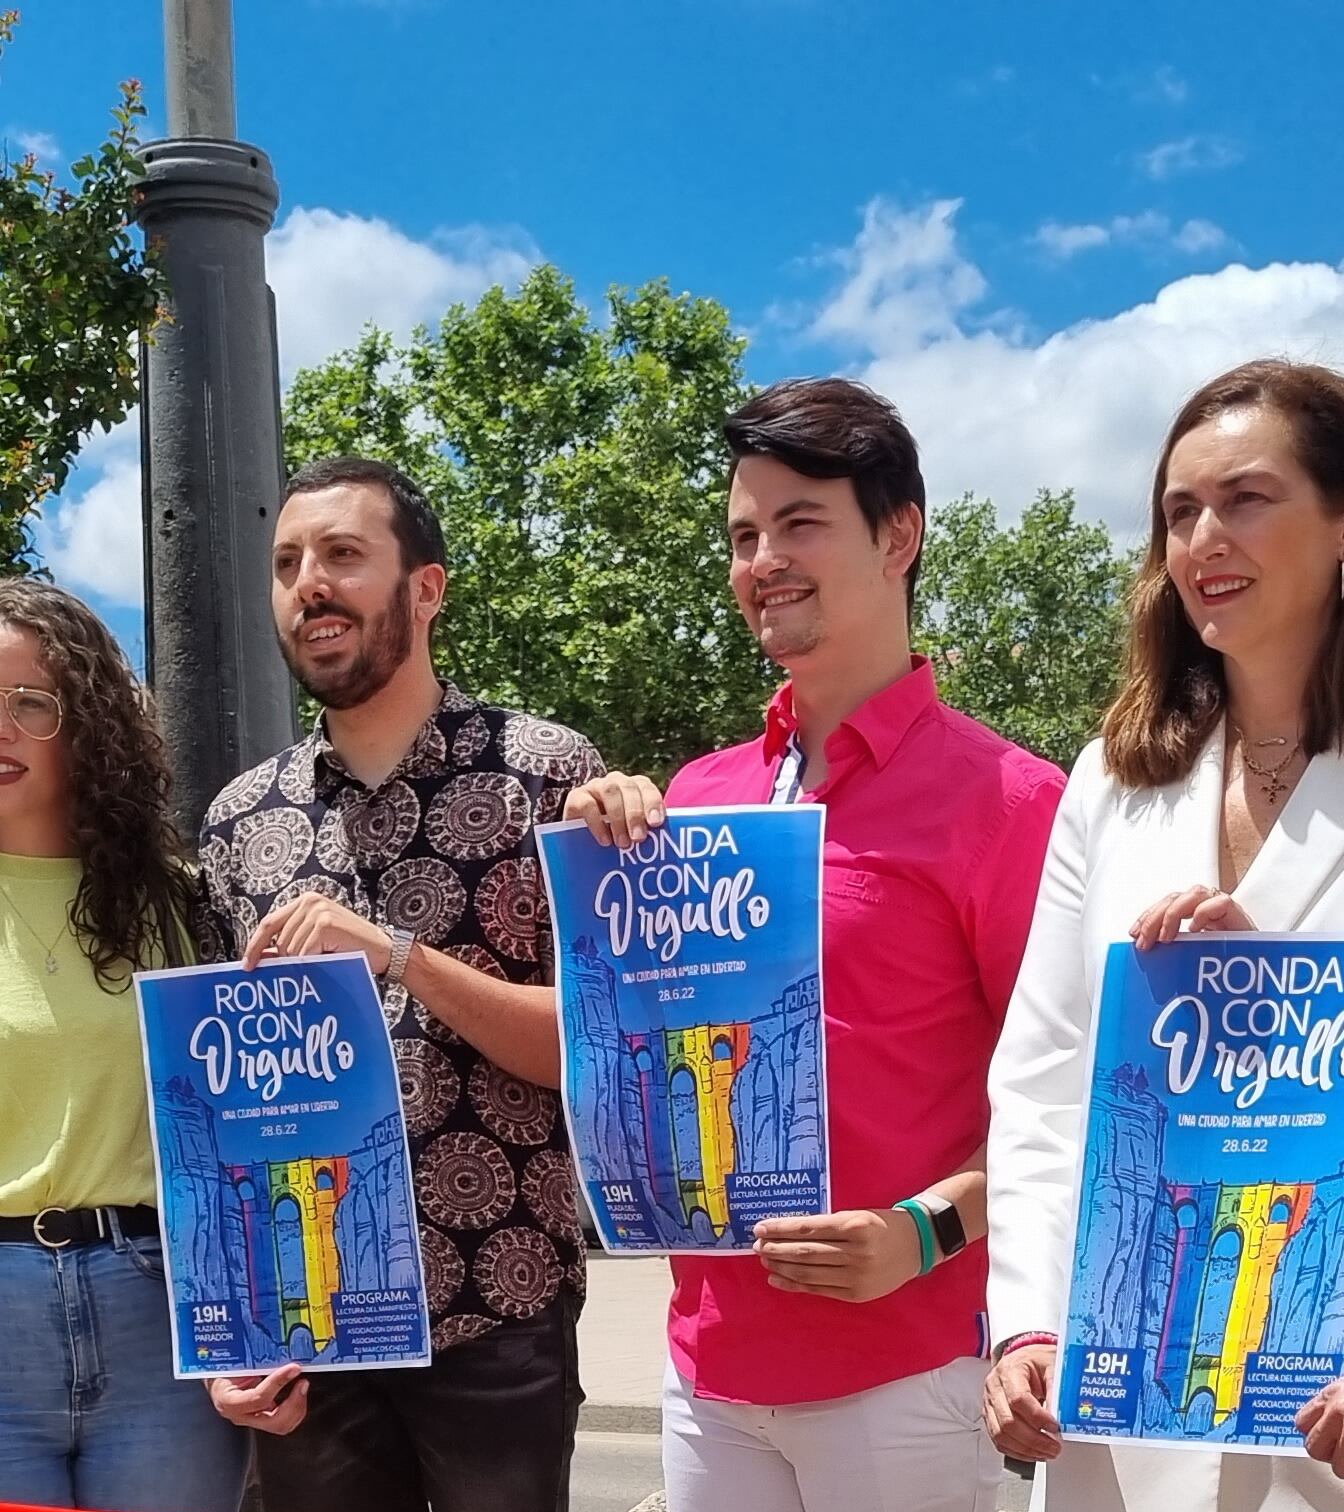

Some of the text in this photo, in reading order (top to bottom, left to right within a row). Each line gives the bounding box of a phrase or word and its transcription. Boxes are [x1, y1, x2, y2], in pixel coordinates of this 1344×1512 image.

[619, 825, 739, 866] RONDA
[639, 862, 710, 900] CON
[594, 868, 770, 962] Orgullo
[660, 967, 677, 980] PARA
[678, 964, 698, 976] AMAR
[700, 963, 710, 975] EN
[712, 960, 746, 973] LIBERTAD
[1198, 956, 1344, 994] RONDA
[214, 975, 321, 1015] RONDA
[658, 987, 695, 1002] 28.6.22
[1222, 1000, 1311, 1036] CON
[238, 1009, 303, 1044] CON
[190, 1015, 354, 1101] Orgullo
[222, 1100, 339, 1120] UNA CIUDAD PARA AMAR EN LIBERTAD
[1178, 1113, 1327, 1128] UNA CIUDAD PARA AMAR EN LIBERTAD
[260, 1124, 298, 1137] 28.6.22
[1222, 1139, 1268, 1152] 28.6.22
[736, 1173, 810, 1188] PROGRAMA
[602, 1184, 638, 1202] 19H.
[773, 1187, 817, 1196] MANIFIESTO
[342, 1290, 410, 1305] PROGRAMA
[192, 1304, 232, 1324] 19H.
[336, 1308, 364, 1316] LECTURA
[194, 1332, 233, 1342] PARADOR
[1084, 1352, 1131, 1375] 19H.
[1258, 1356, 1334, 1371] PROGRAMA
[1082, 1376, 1122, 1386] PLAZA DEL
[1248, 1373, 1280, 1382] LECTURA
[1080, 1387, 1126, 1398] PARADOR
[1254, 1426, 1262, 1434] DJ
[1262, 1425, 1292, 1434] MARCOS
